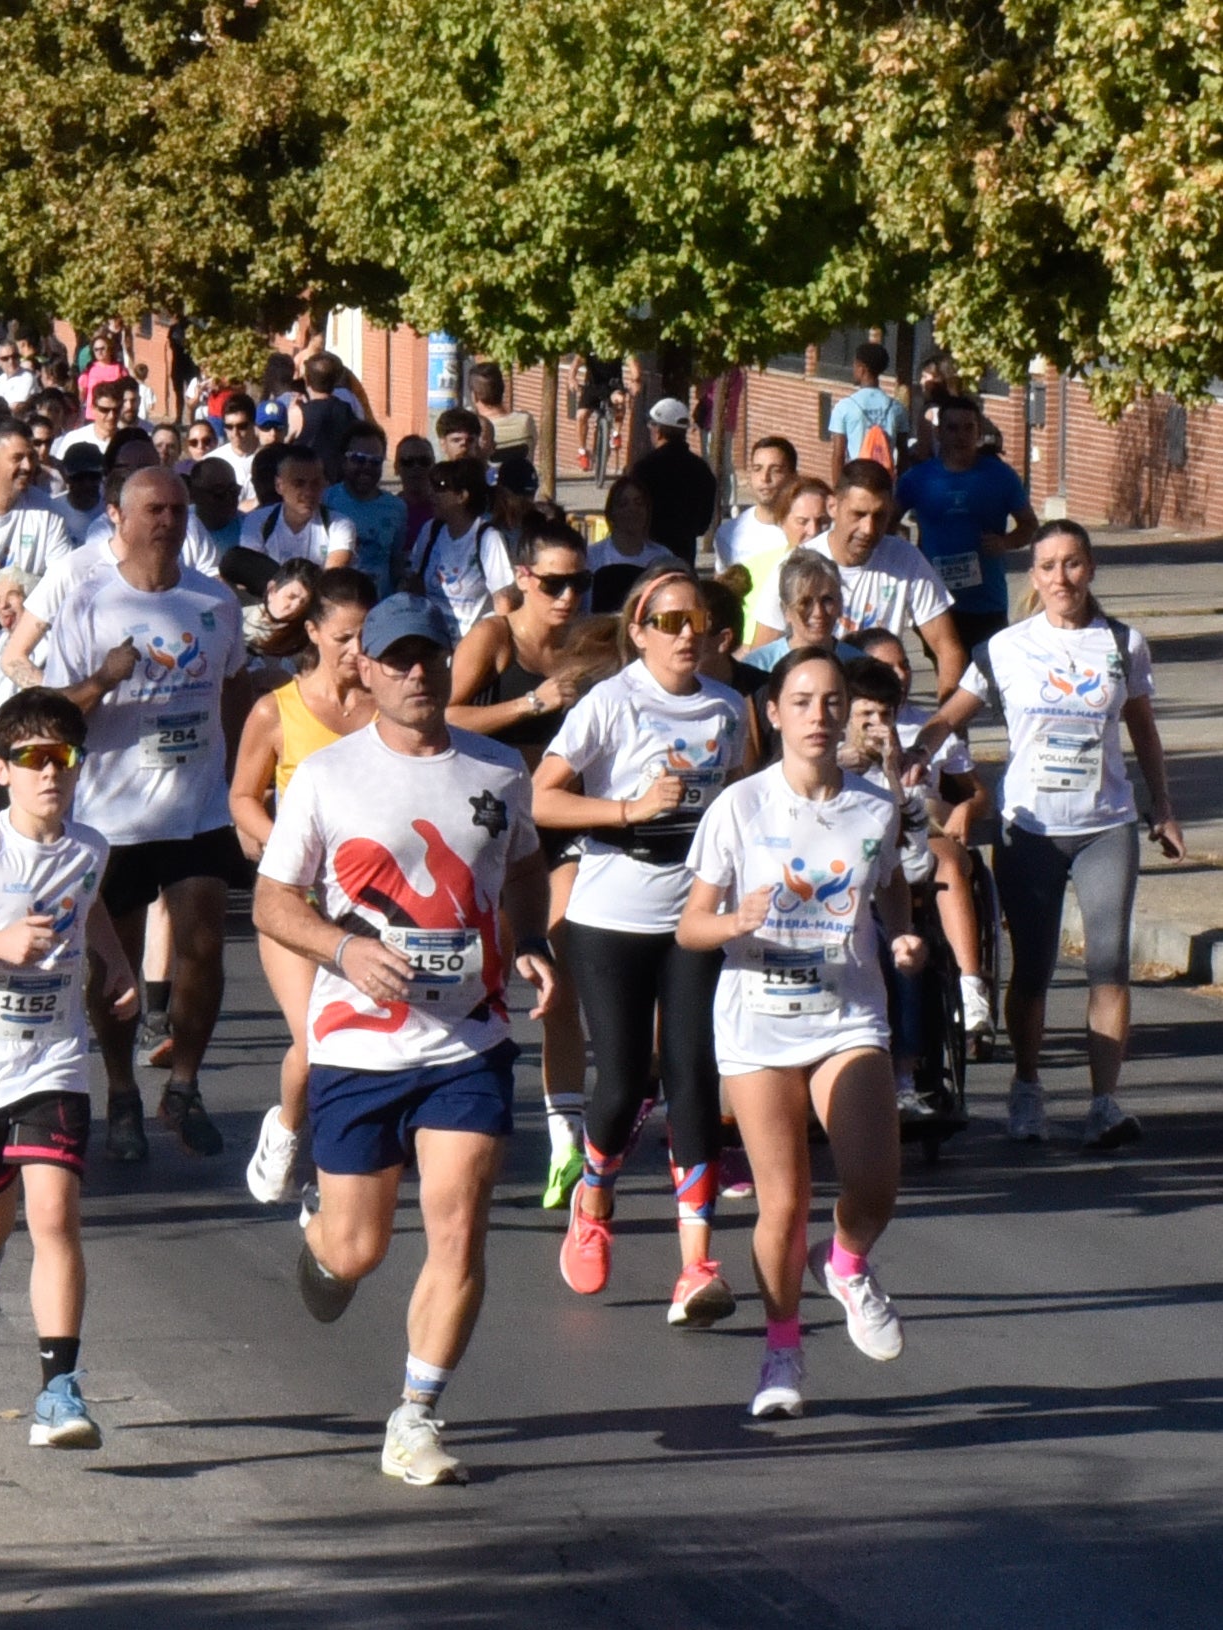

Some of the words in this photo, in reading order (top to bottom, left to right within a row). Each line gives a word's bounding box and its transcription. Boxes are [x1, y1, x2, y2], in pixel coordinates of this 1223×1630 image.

[159, 728, 197, 744] 284
[1038, 753, 1100, 766] VOLUNTARIO
[410, 954, 465, 972] 150
[762, 967, 821, 985] 1151
[0, 995, 57, 1012] 1152
